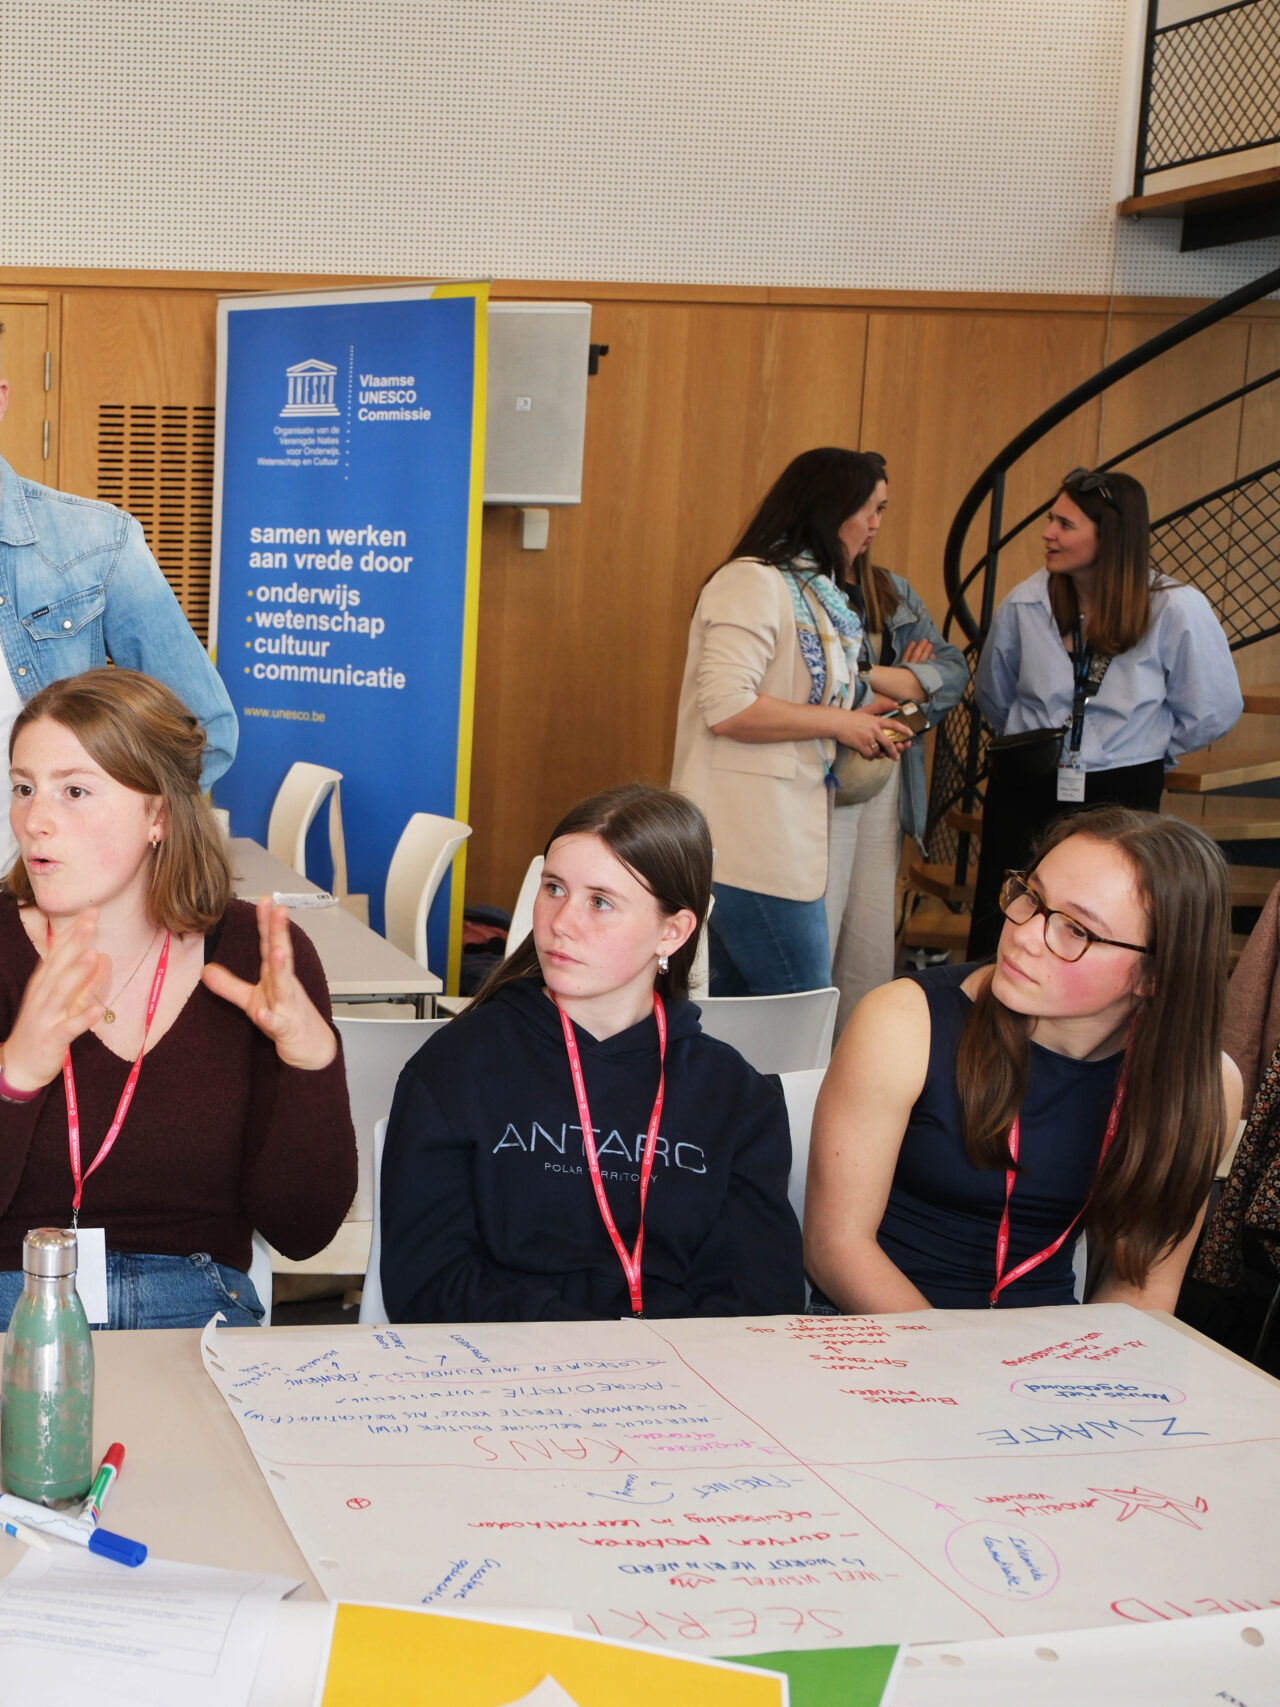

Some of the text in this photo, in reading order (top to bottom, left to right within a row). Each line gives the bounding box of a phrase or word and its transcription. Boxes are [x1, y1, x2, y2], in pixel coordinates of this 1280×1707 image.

[359, 374, 415, 387] Vlaamse
[358, 390, 417, 404] UNESCO
[357, 407, 431, 421] Commissie
[273, 426, 340, 437] Organisatie van de
[279, 437, 340, 447] Verenigde Naties
[286, 447, 302, 456] voor
[257, 457, 339, 467] Wetenschap en Cultuur
[250, 524, 406, 547] samen werken
[249, 550, 413, 573] aan vrede door
[256, 583, 361, 611] onderwijs
[255, 609, 385, 639] wetenschap
[254, 635, 330, 657] cultuur
[253, 660, 406, 689] communicatie
[243, 706, 326, 723] www.unesco.be
[544, 1162, 583, 1175] POLAR
[491, 1366, 520, 1375] VAN
[1024, 1383, 1139, 1393] opgebouwd
[863, 1397, 959, 1406] Bundels
[670, 1416, 710, 1425] MEER
[977, 1417, 1211, 1447] ZWAKTE
[474, 1436, 639, 1465] KANS
[649, 1518, 676, 1528] in
